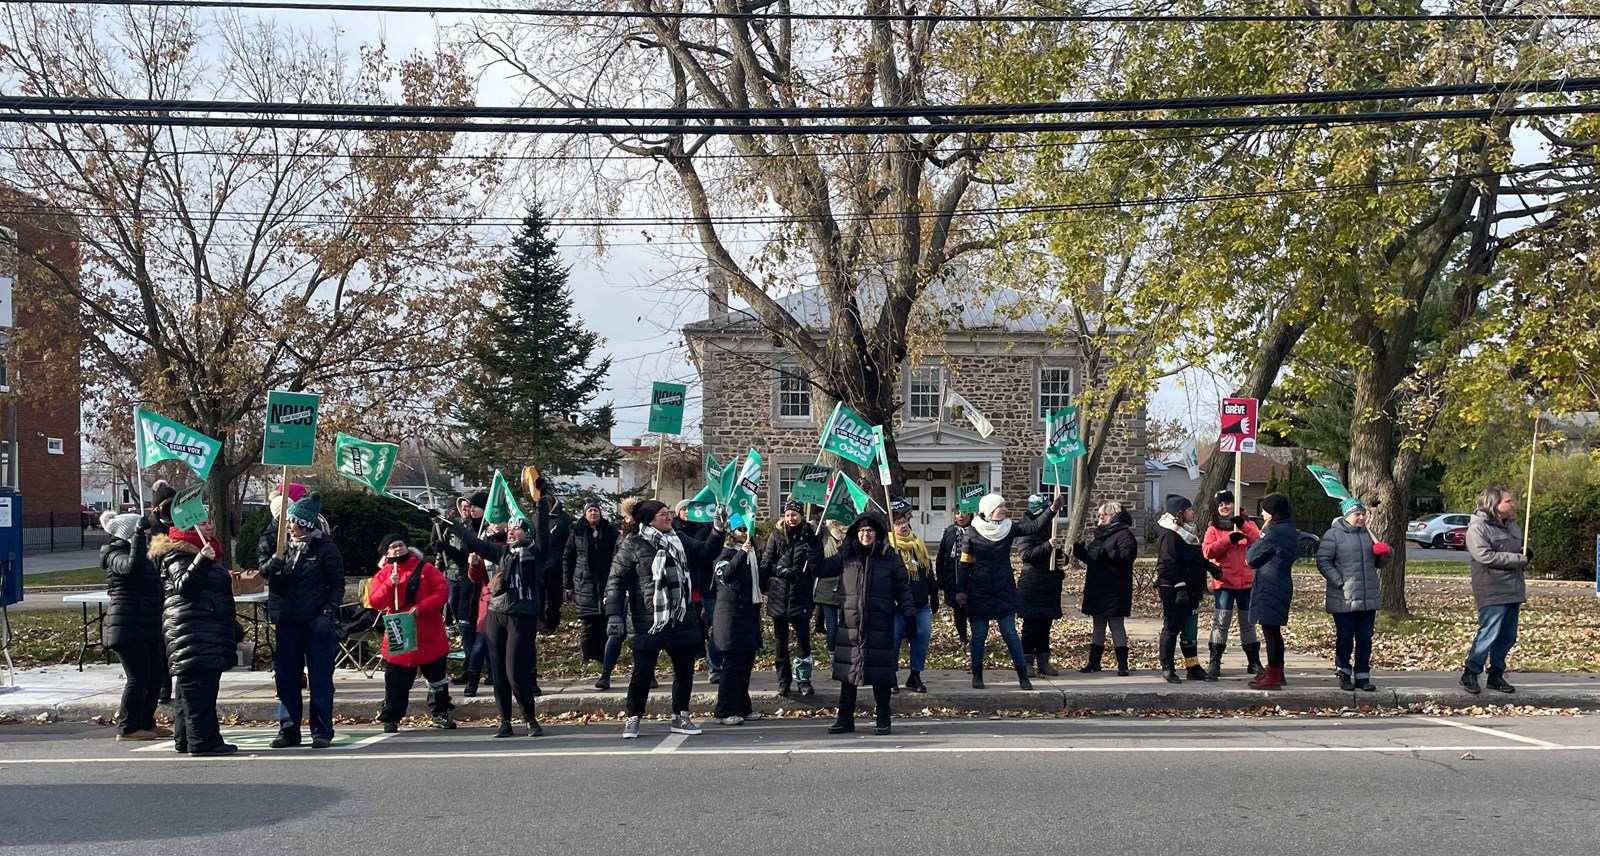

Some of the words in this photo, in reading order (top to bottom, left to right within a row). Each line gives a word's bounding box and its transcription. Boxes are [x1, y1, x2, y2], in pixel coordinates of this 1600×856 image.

[654, 390, 683, 406] NOUS
[271, 404, 315, 426] NOUS
[1225, 404, 1246, 415] GRÈVE
[169, 444, 186, 452] SEULE
[187, 446, 201, 455] VOIX
[800, 465, 830, 484] NOUS
[742, 479, 757, 491] D'UNE
[960, 485, 984, 499] NOUS
[386, 618, 403, 652] NOUS
